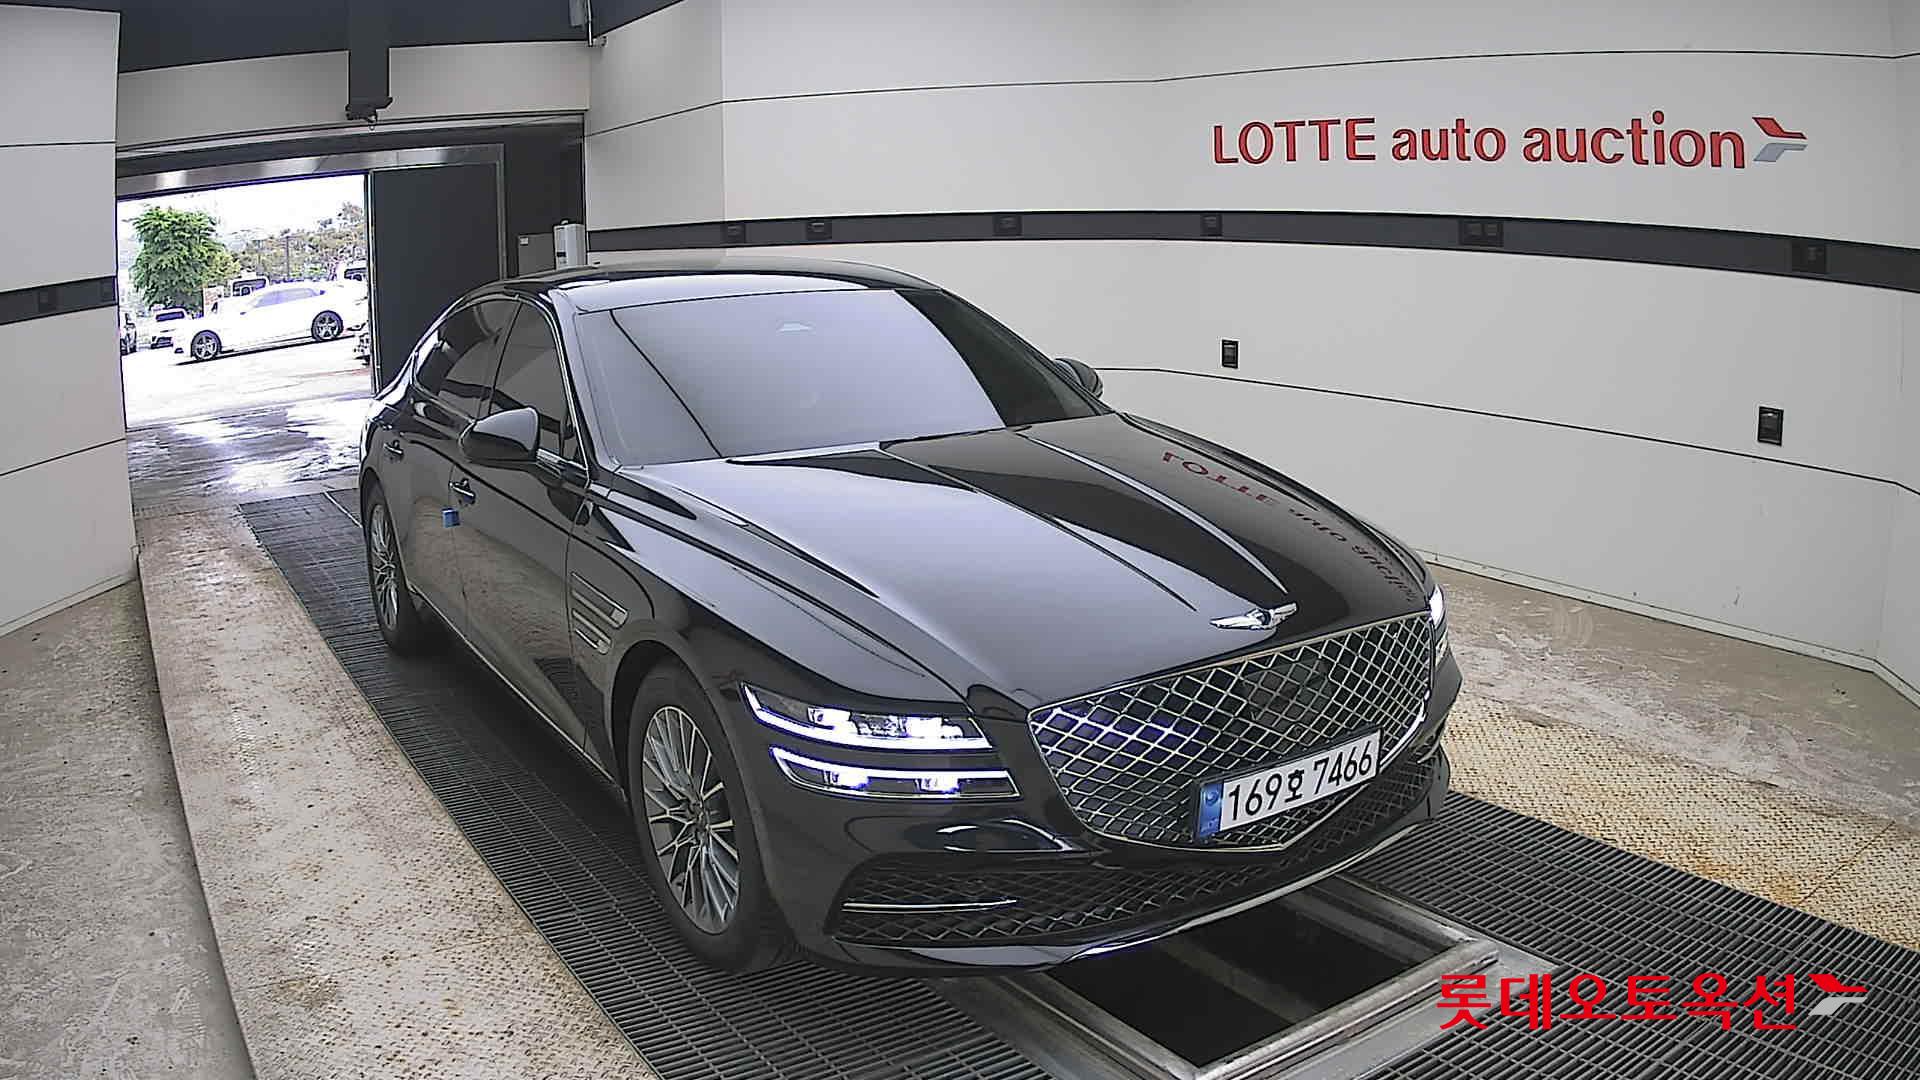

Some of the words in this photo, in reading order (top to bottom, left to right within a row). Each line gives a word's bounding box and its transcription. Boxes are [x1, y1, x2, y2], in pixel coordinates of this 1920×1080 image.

[1213, 118, 1376, 165] LOTTE
[1391, 118, 1507, 162] auto
[1523, 110, 1745, 169] auction
[1228, 768, 1305, 821] 169호
[1313, 740, 1373, 796] 7466
